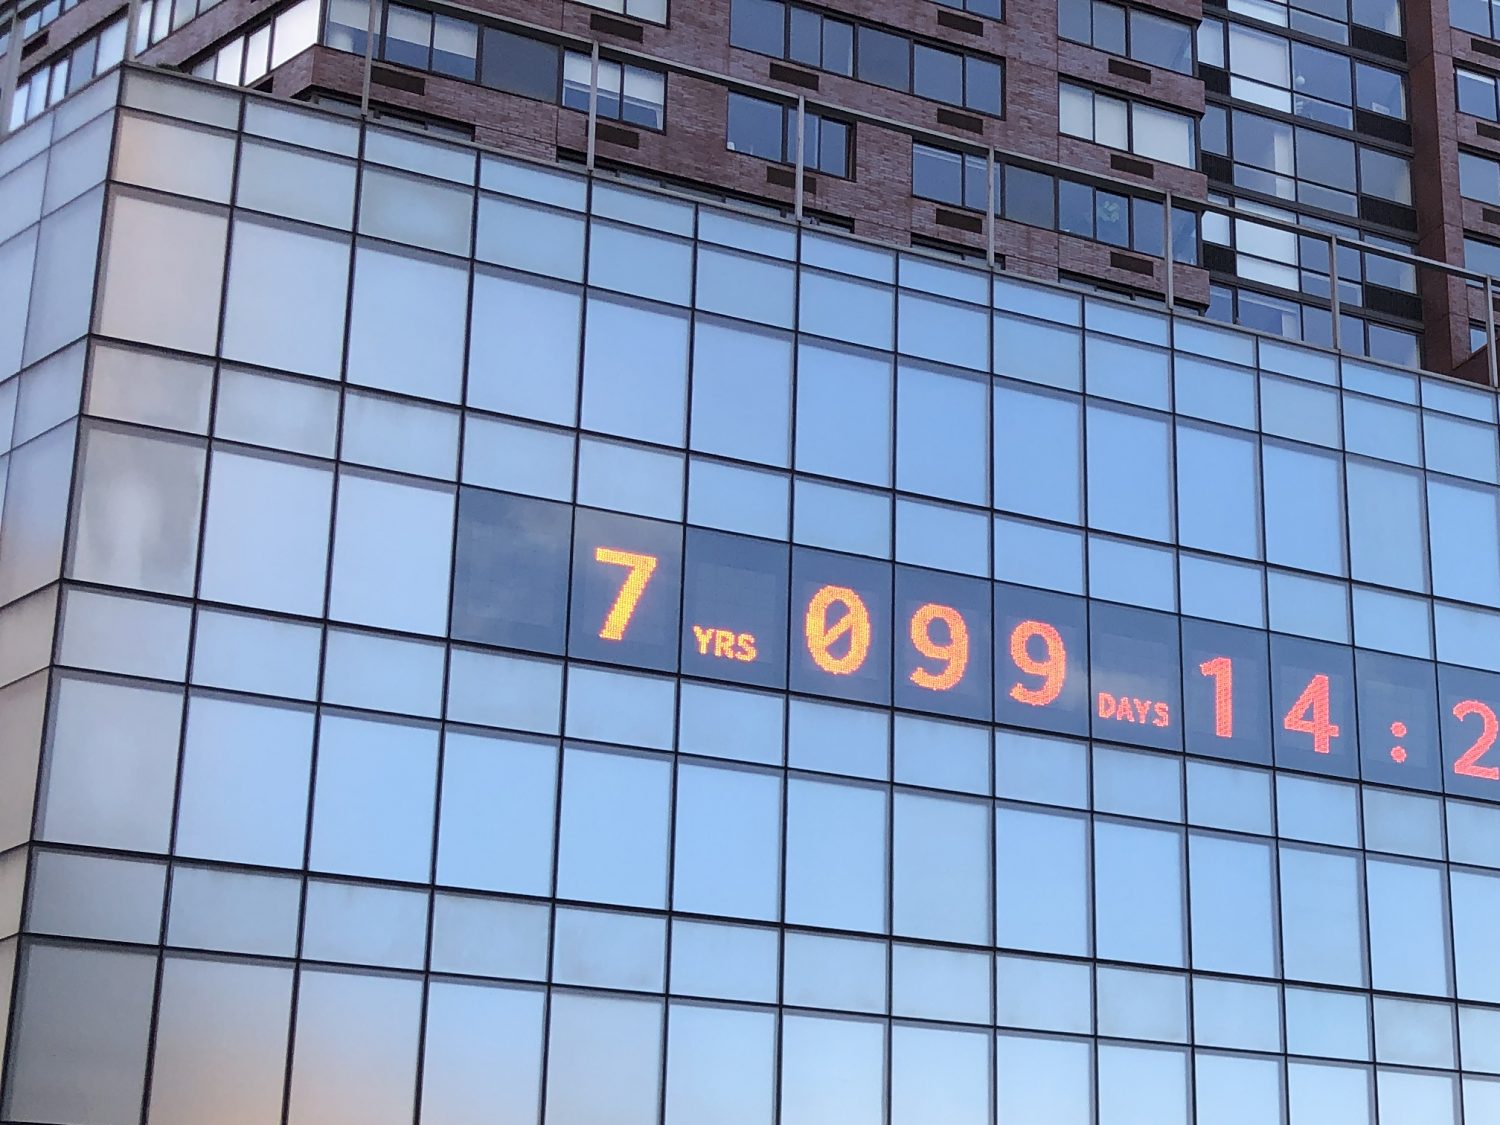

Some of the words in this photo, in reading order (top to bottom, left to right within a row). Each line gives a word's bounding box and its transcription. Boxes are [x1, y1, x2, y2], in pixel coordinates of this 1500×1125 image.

[595, 547, 657, 641] 7
[693, 624, 758, 663] YRS
[1098, 692, 1169, 728] DAYS
